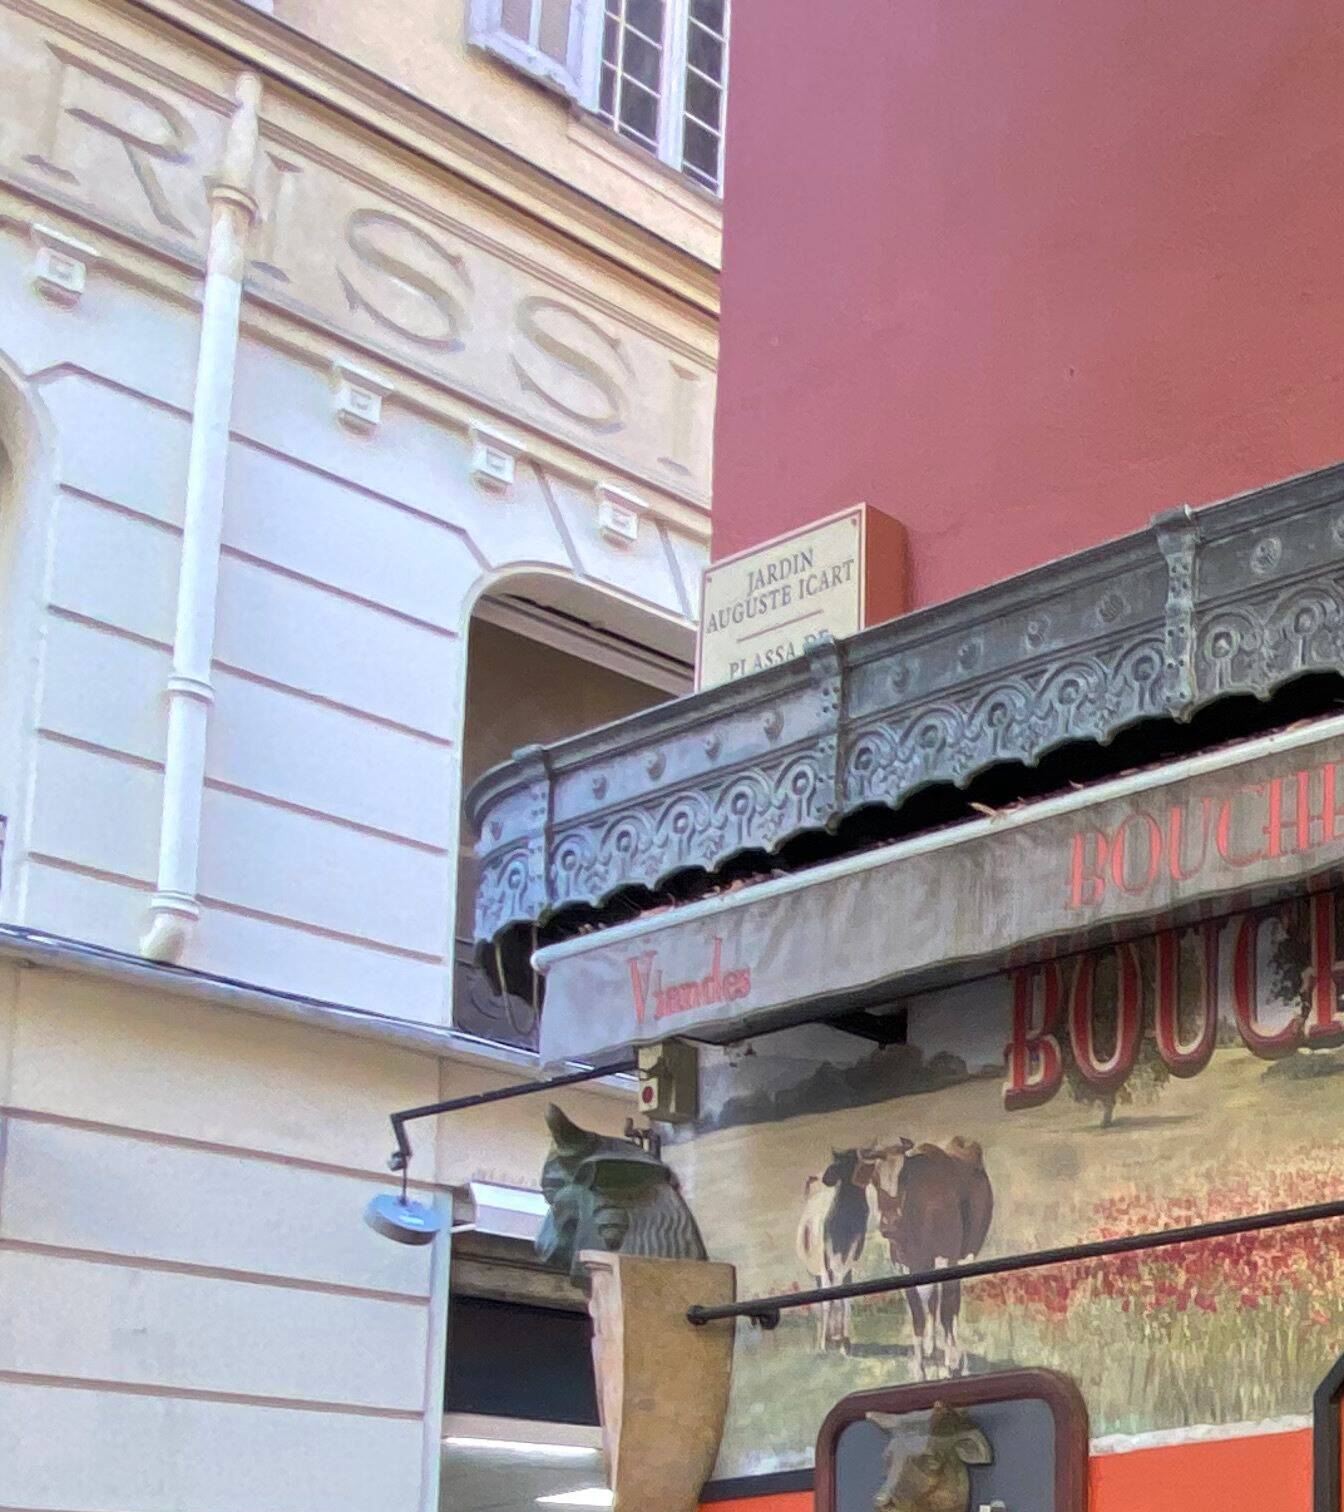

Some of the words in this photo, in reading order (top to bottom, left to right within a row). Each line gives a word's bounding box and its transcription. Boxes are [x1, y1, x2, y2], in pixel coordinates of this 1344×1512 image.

[704, 584, 793, 635] AUGUSTE
[798, 558, 856, 601] ICART
[748, 547, 815, 594] JARDIN
